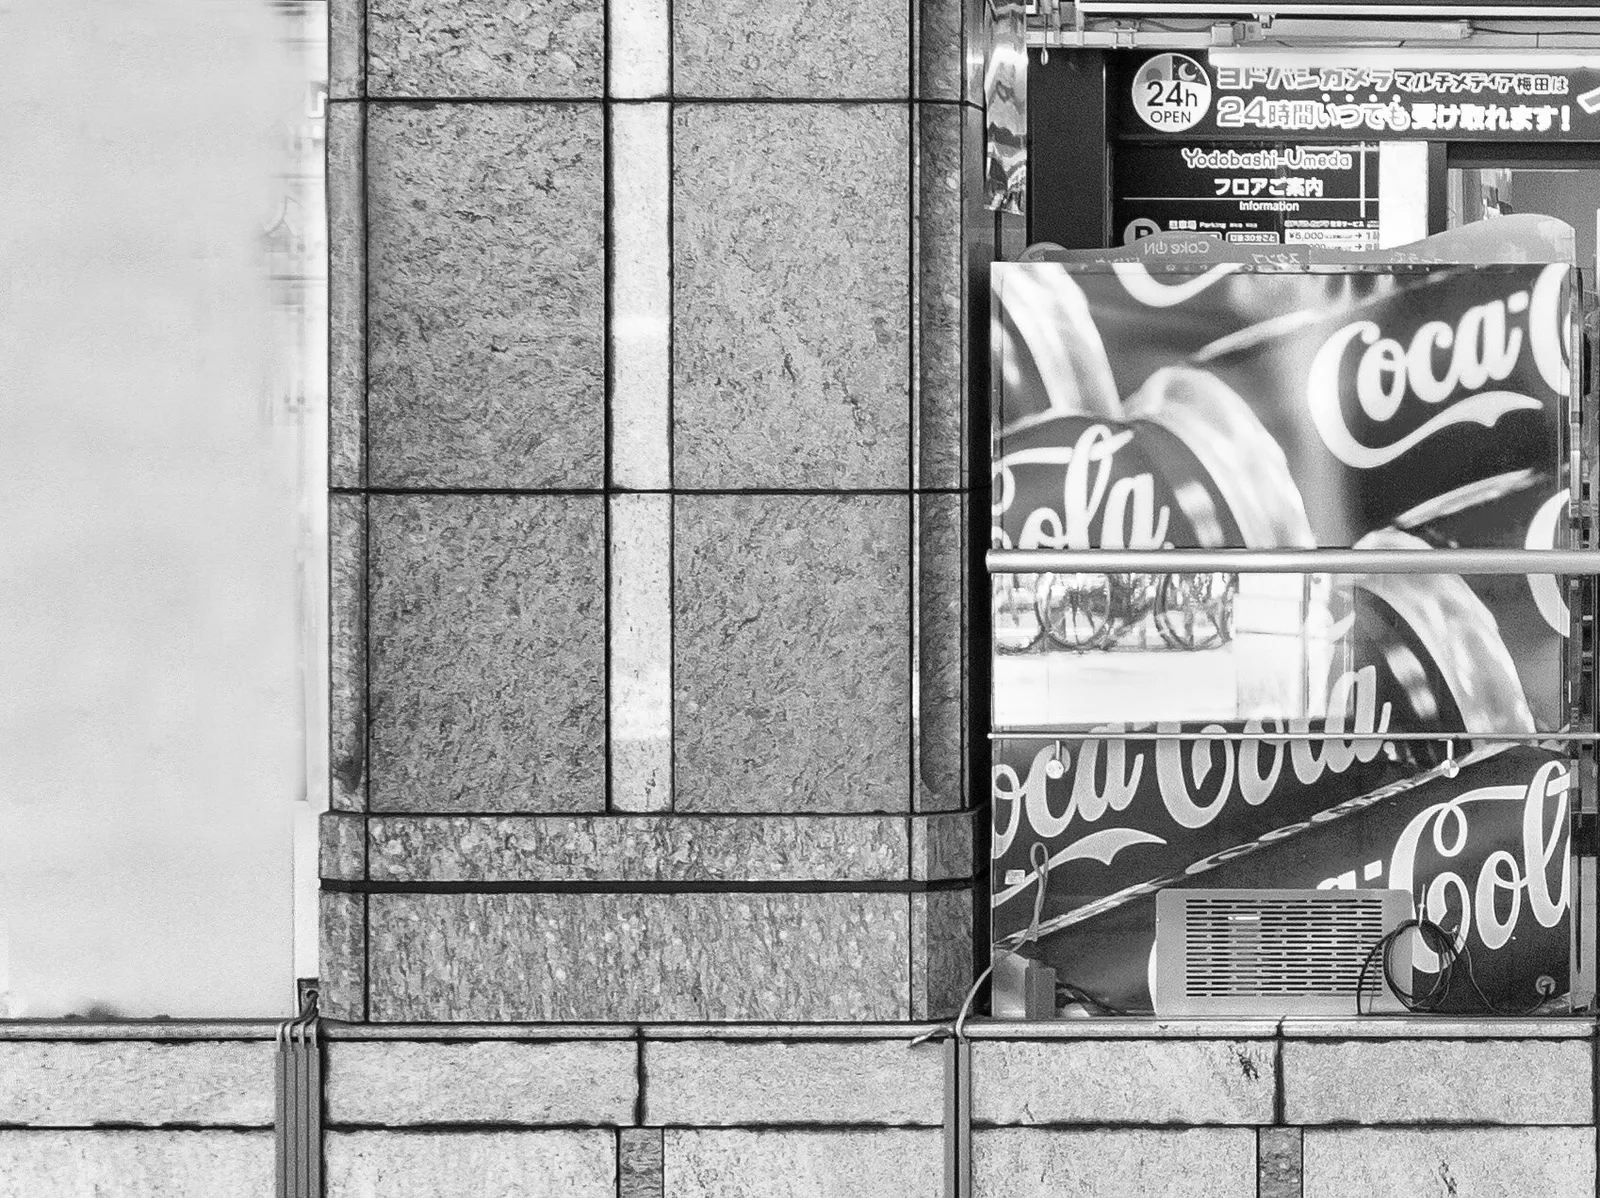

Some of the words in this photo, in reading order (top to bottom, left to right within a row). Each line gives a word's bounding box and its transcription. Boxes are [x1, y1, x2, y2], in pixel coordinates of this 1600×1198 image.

[1147, 81, 1198, 108] 24h
[1150, 110, 1191, 123] OPEN
[1181, 148, 1352, 169] Yodobashi-Umeda
[1214, 177, 1323, 197] フロアご案内
[1239, 201, 1300, 212] Information
